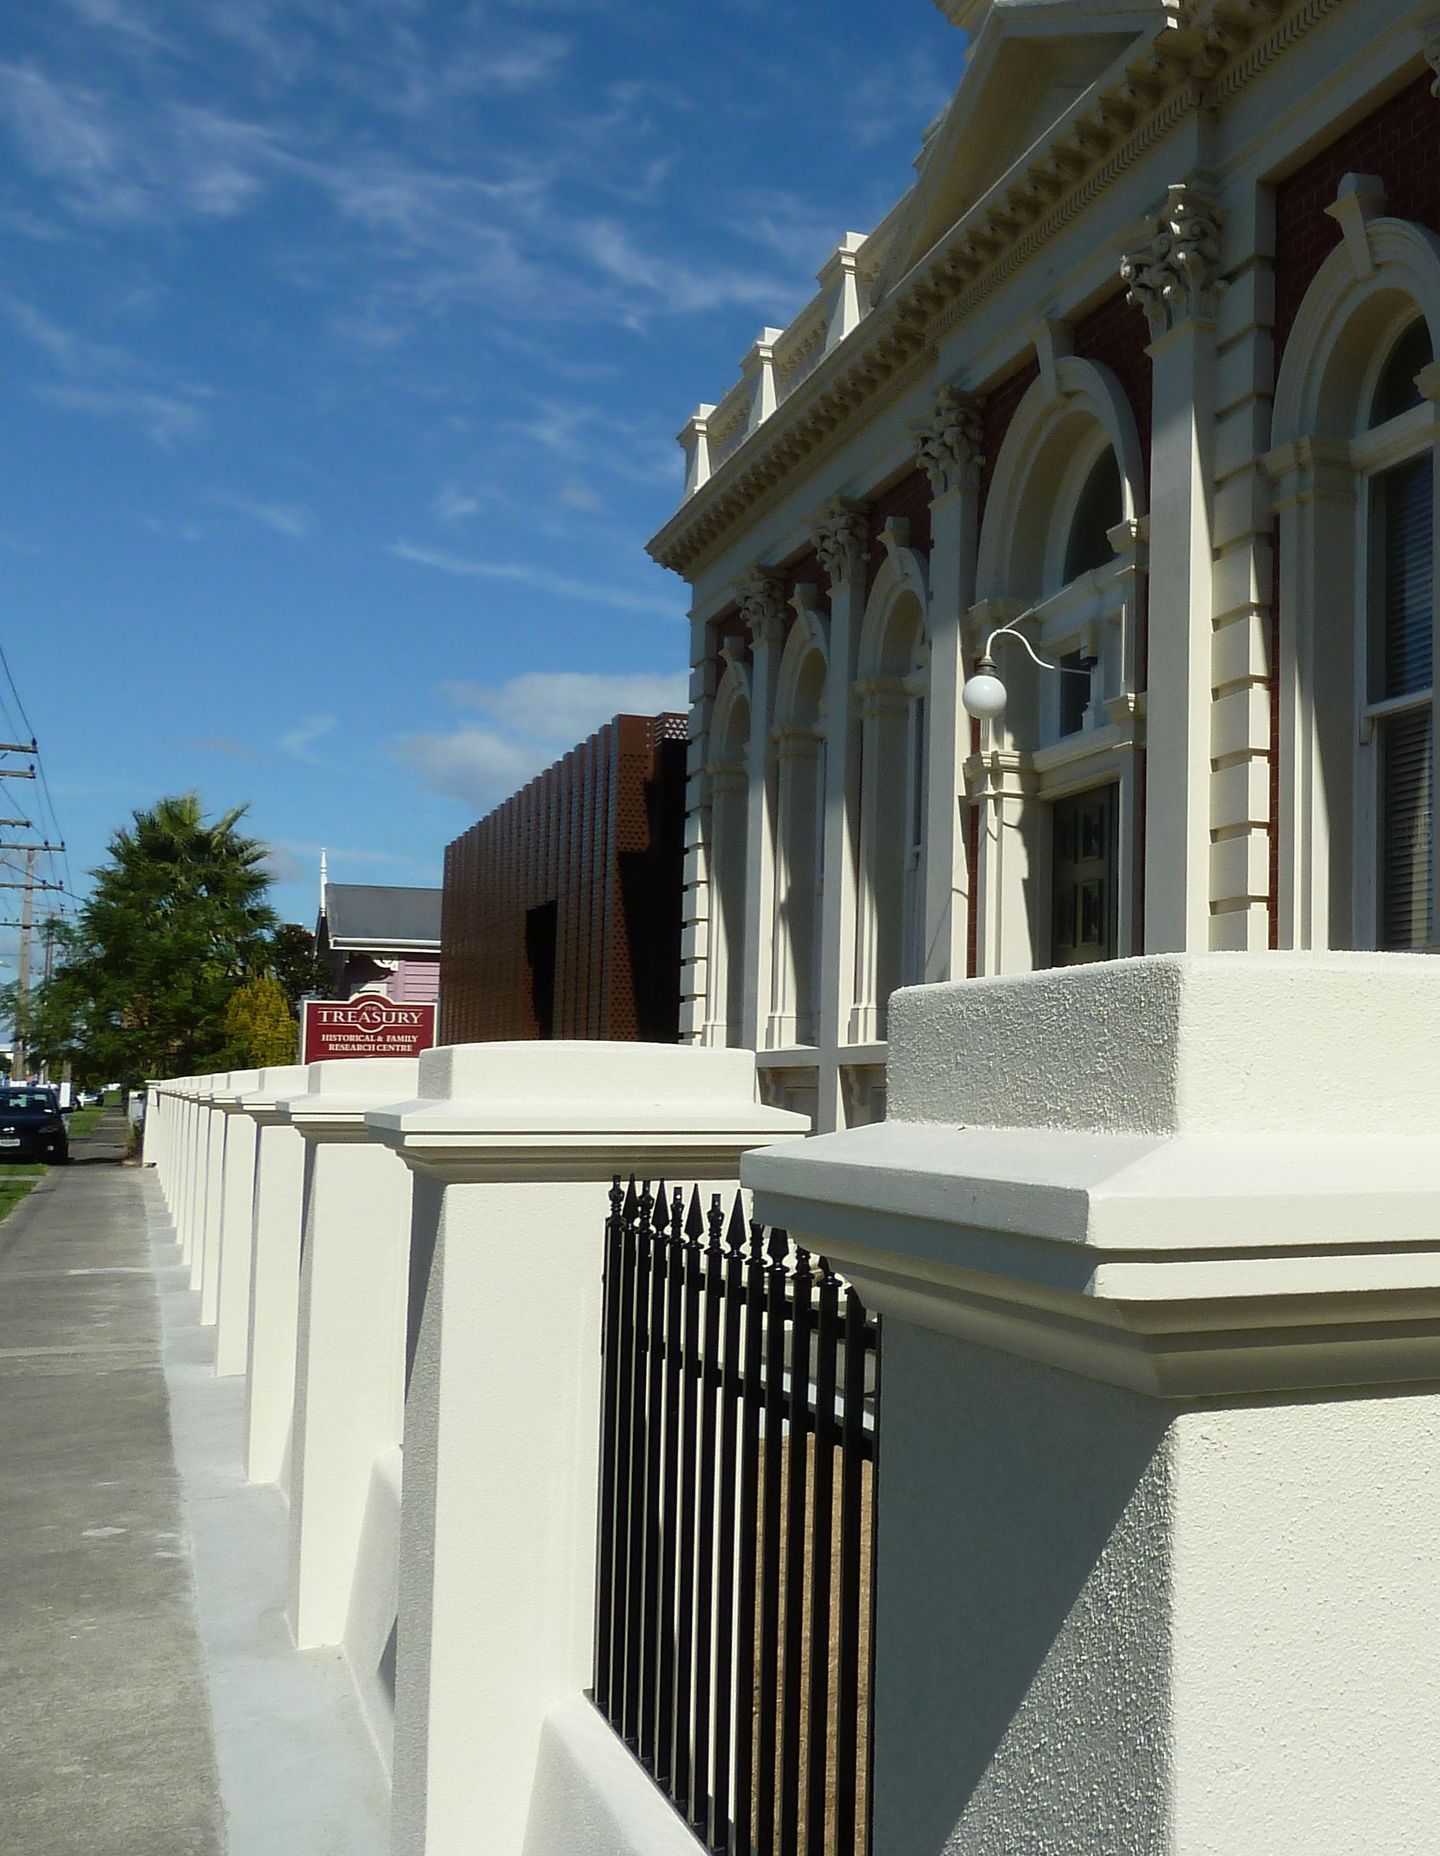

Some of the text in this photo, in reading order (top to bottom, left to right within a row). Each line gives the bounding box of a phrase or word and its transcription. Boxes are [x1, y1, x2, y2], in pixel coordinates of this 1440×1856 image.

[318, 1010, 422, 1024] TREASURY
[321, 1034, 376, 1042] HISTORICAL
[386, 1034, 419, 1043] FAMILY
[328, 1044, 413, 1052] RESEARCH CENTRE
